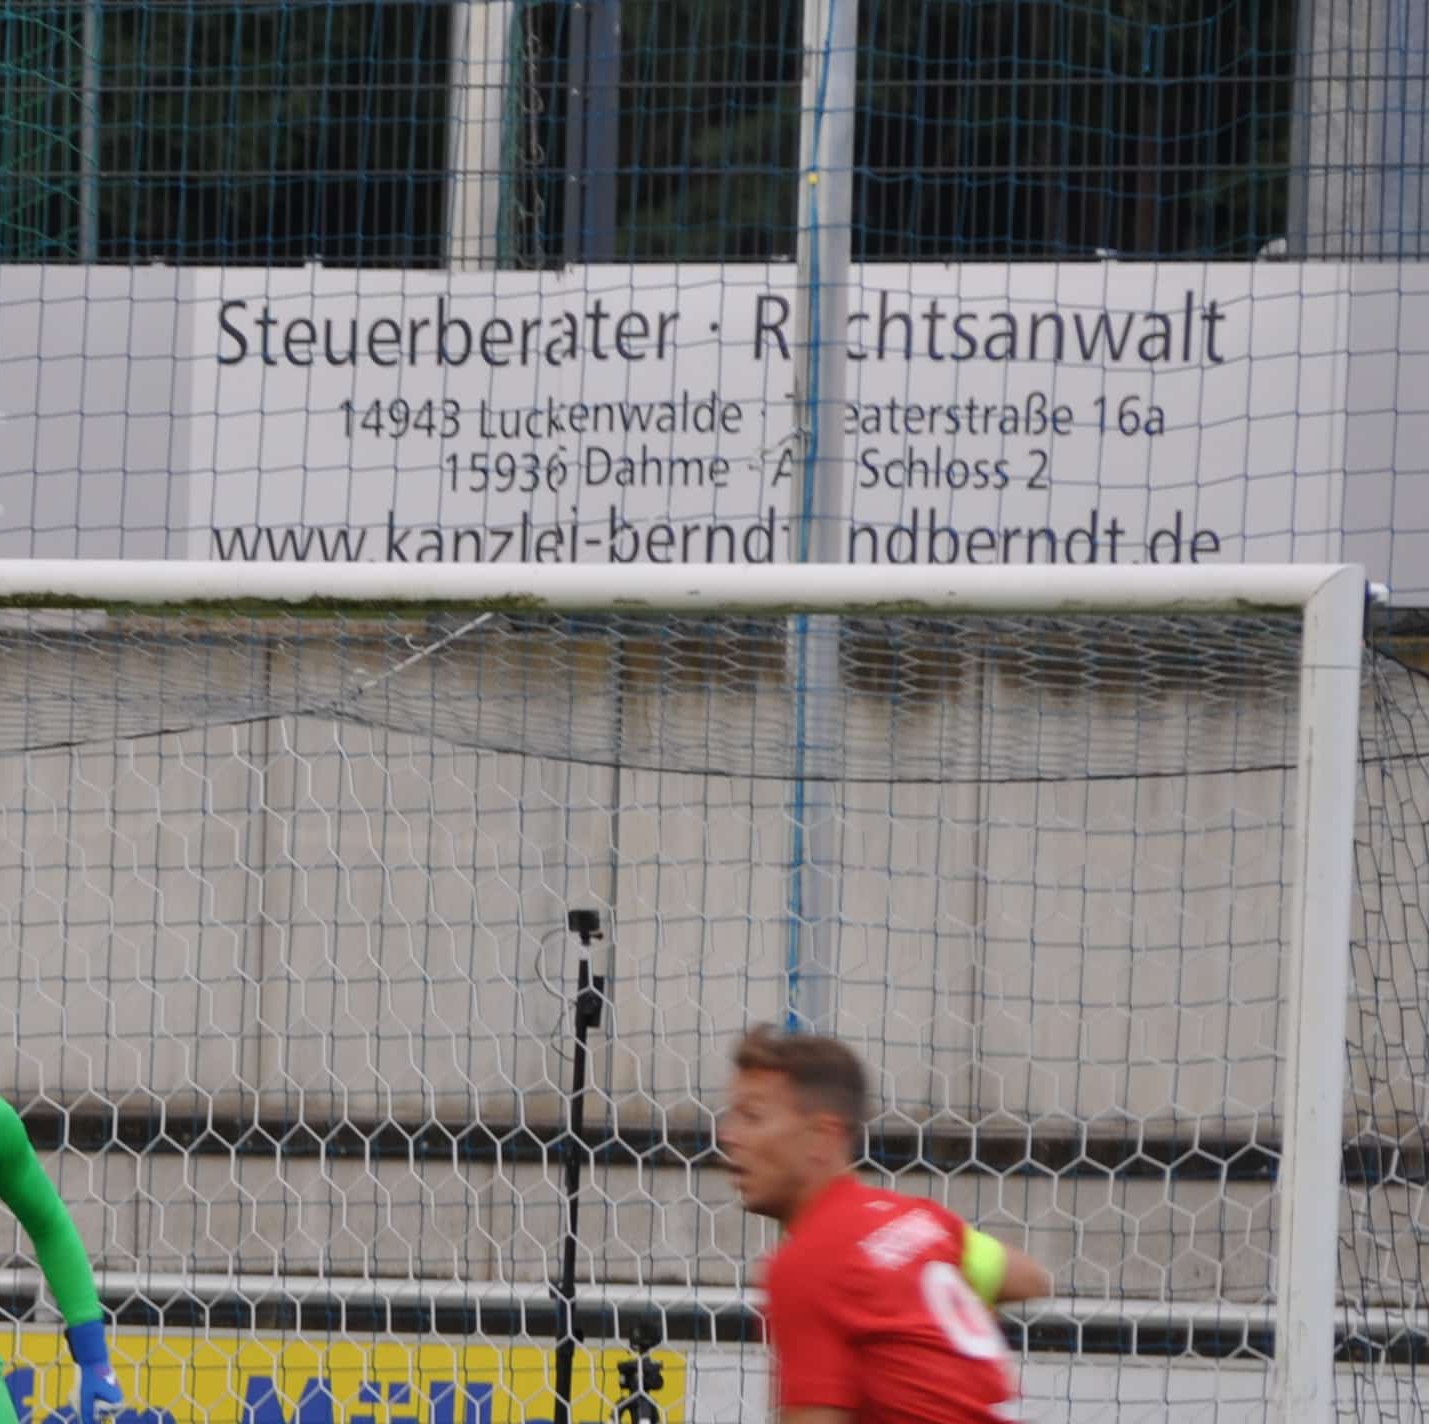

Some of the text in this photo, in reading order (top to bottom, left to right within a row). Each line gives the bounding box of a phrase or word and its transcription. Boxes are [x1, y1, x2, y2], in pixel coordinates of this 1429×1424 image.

[217, 290, 1226, 367] Steuerberater Rchtsanwalt
[340, 390, 1166, 438] 14943 Luckenwalde eaterstraße 16a
[446, 447, 568, 492] 15936
[584, 446, 729, 488] Dahme
[860, 445, 1009, 488] Schloss
[1026, 448, 1050, 488] 2
[213, 502, 1222, 565] www.kanzlei-berndndberndt.de
